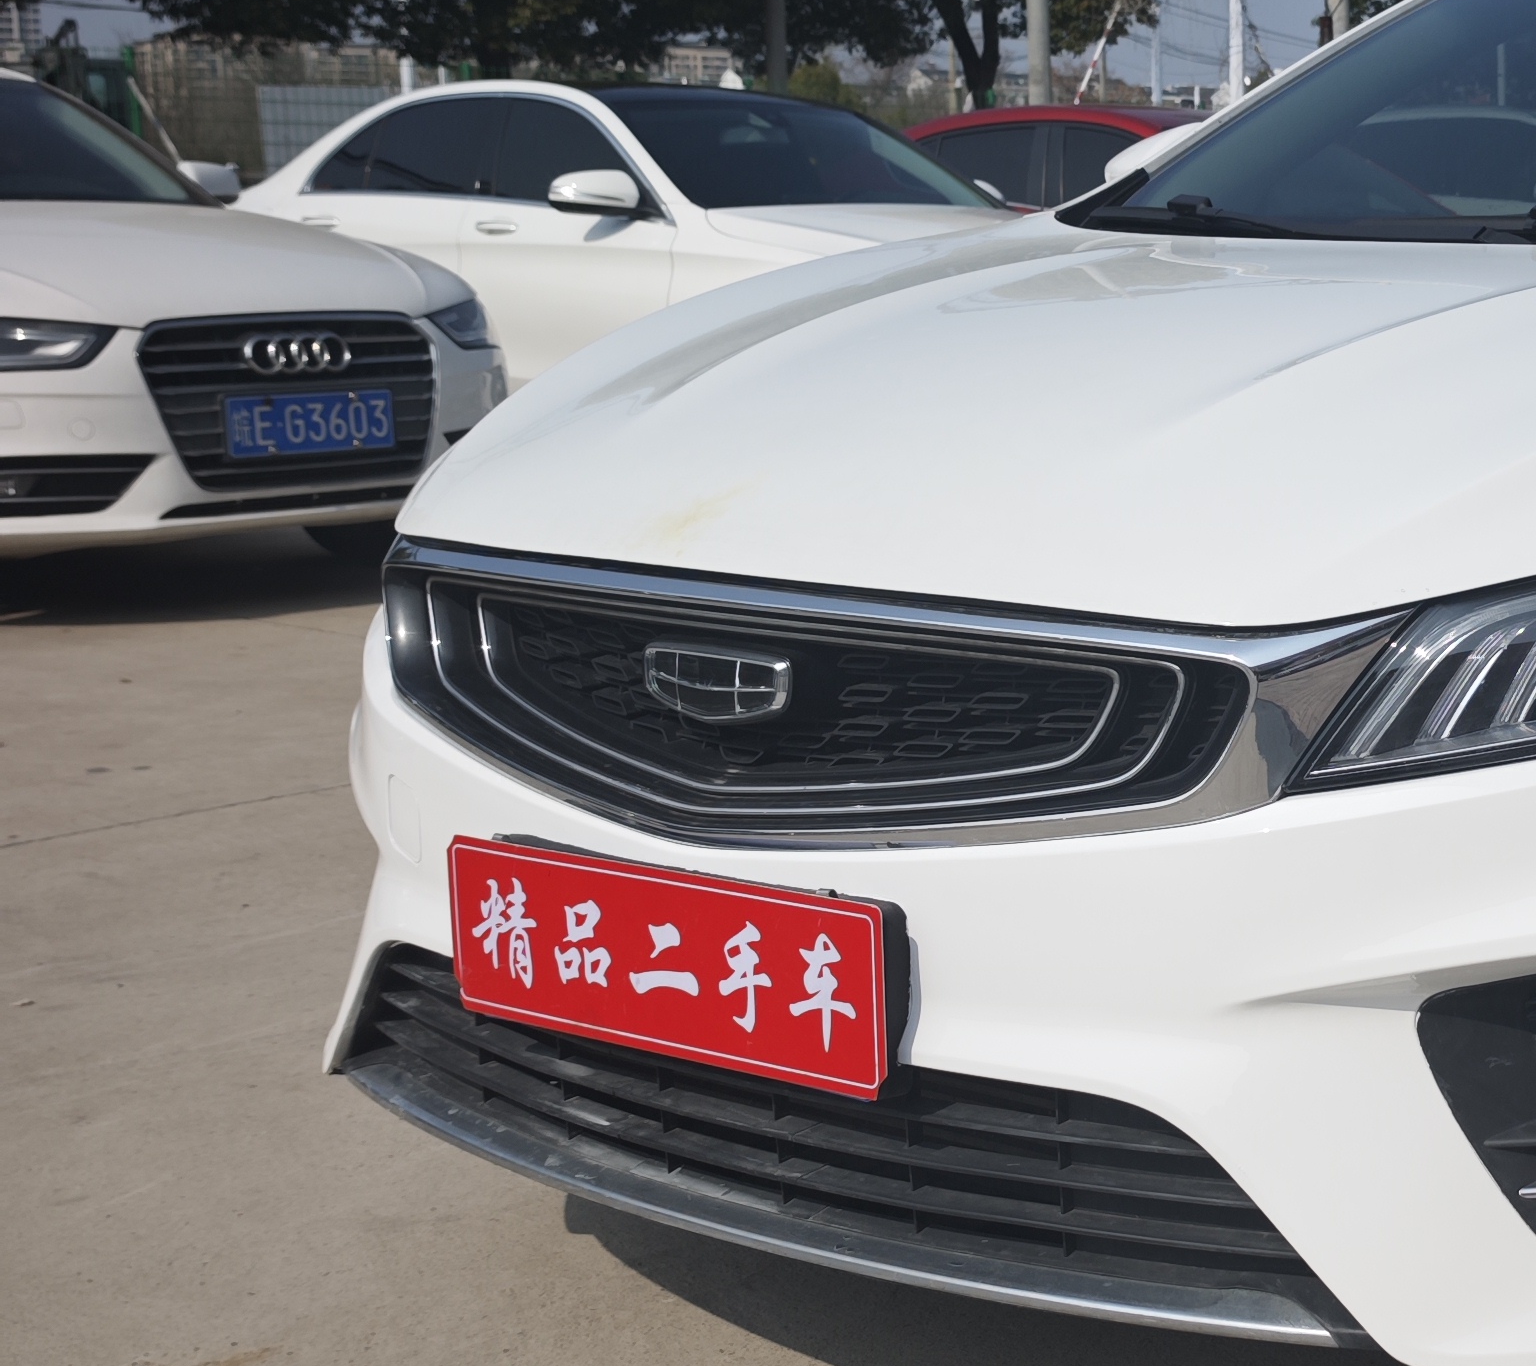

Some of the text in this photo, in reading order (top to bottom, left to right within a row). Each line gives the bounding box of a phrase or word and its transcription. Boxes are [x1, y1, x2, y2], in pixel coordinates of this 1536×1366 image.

[472, 877, 857, 1053] 精品二手车
